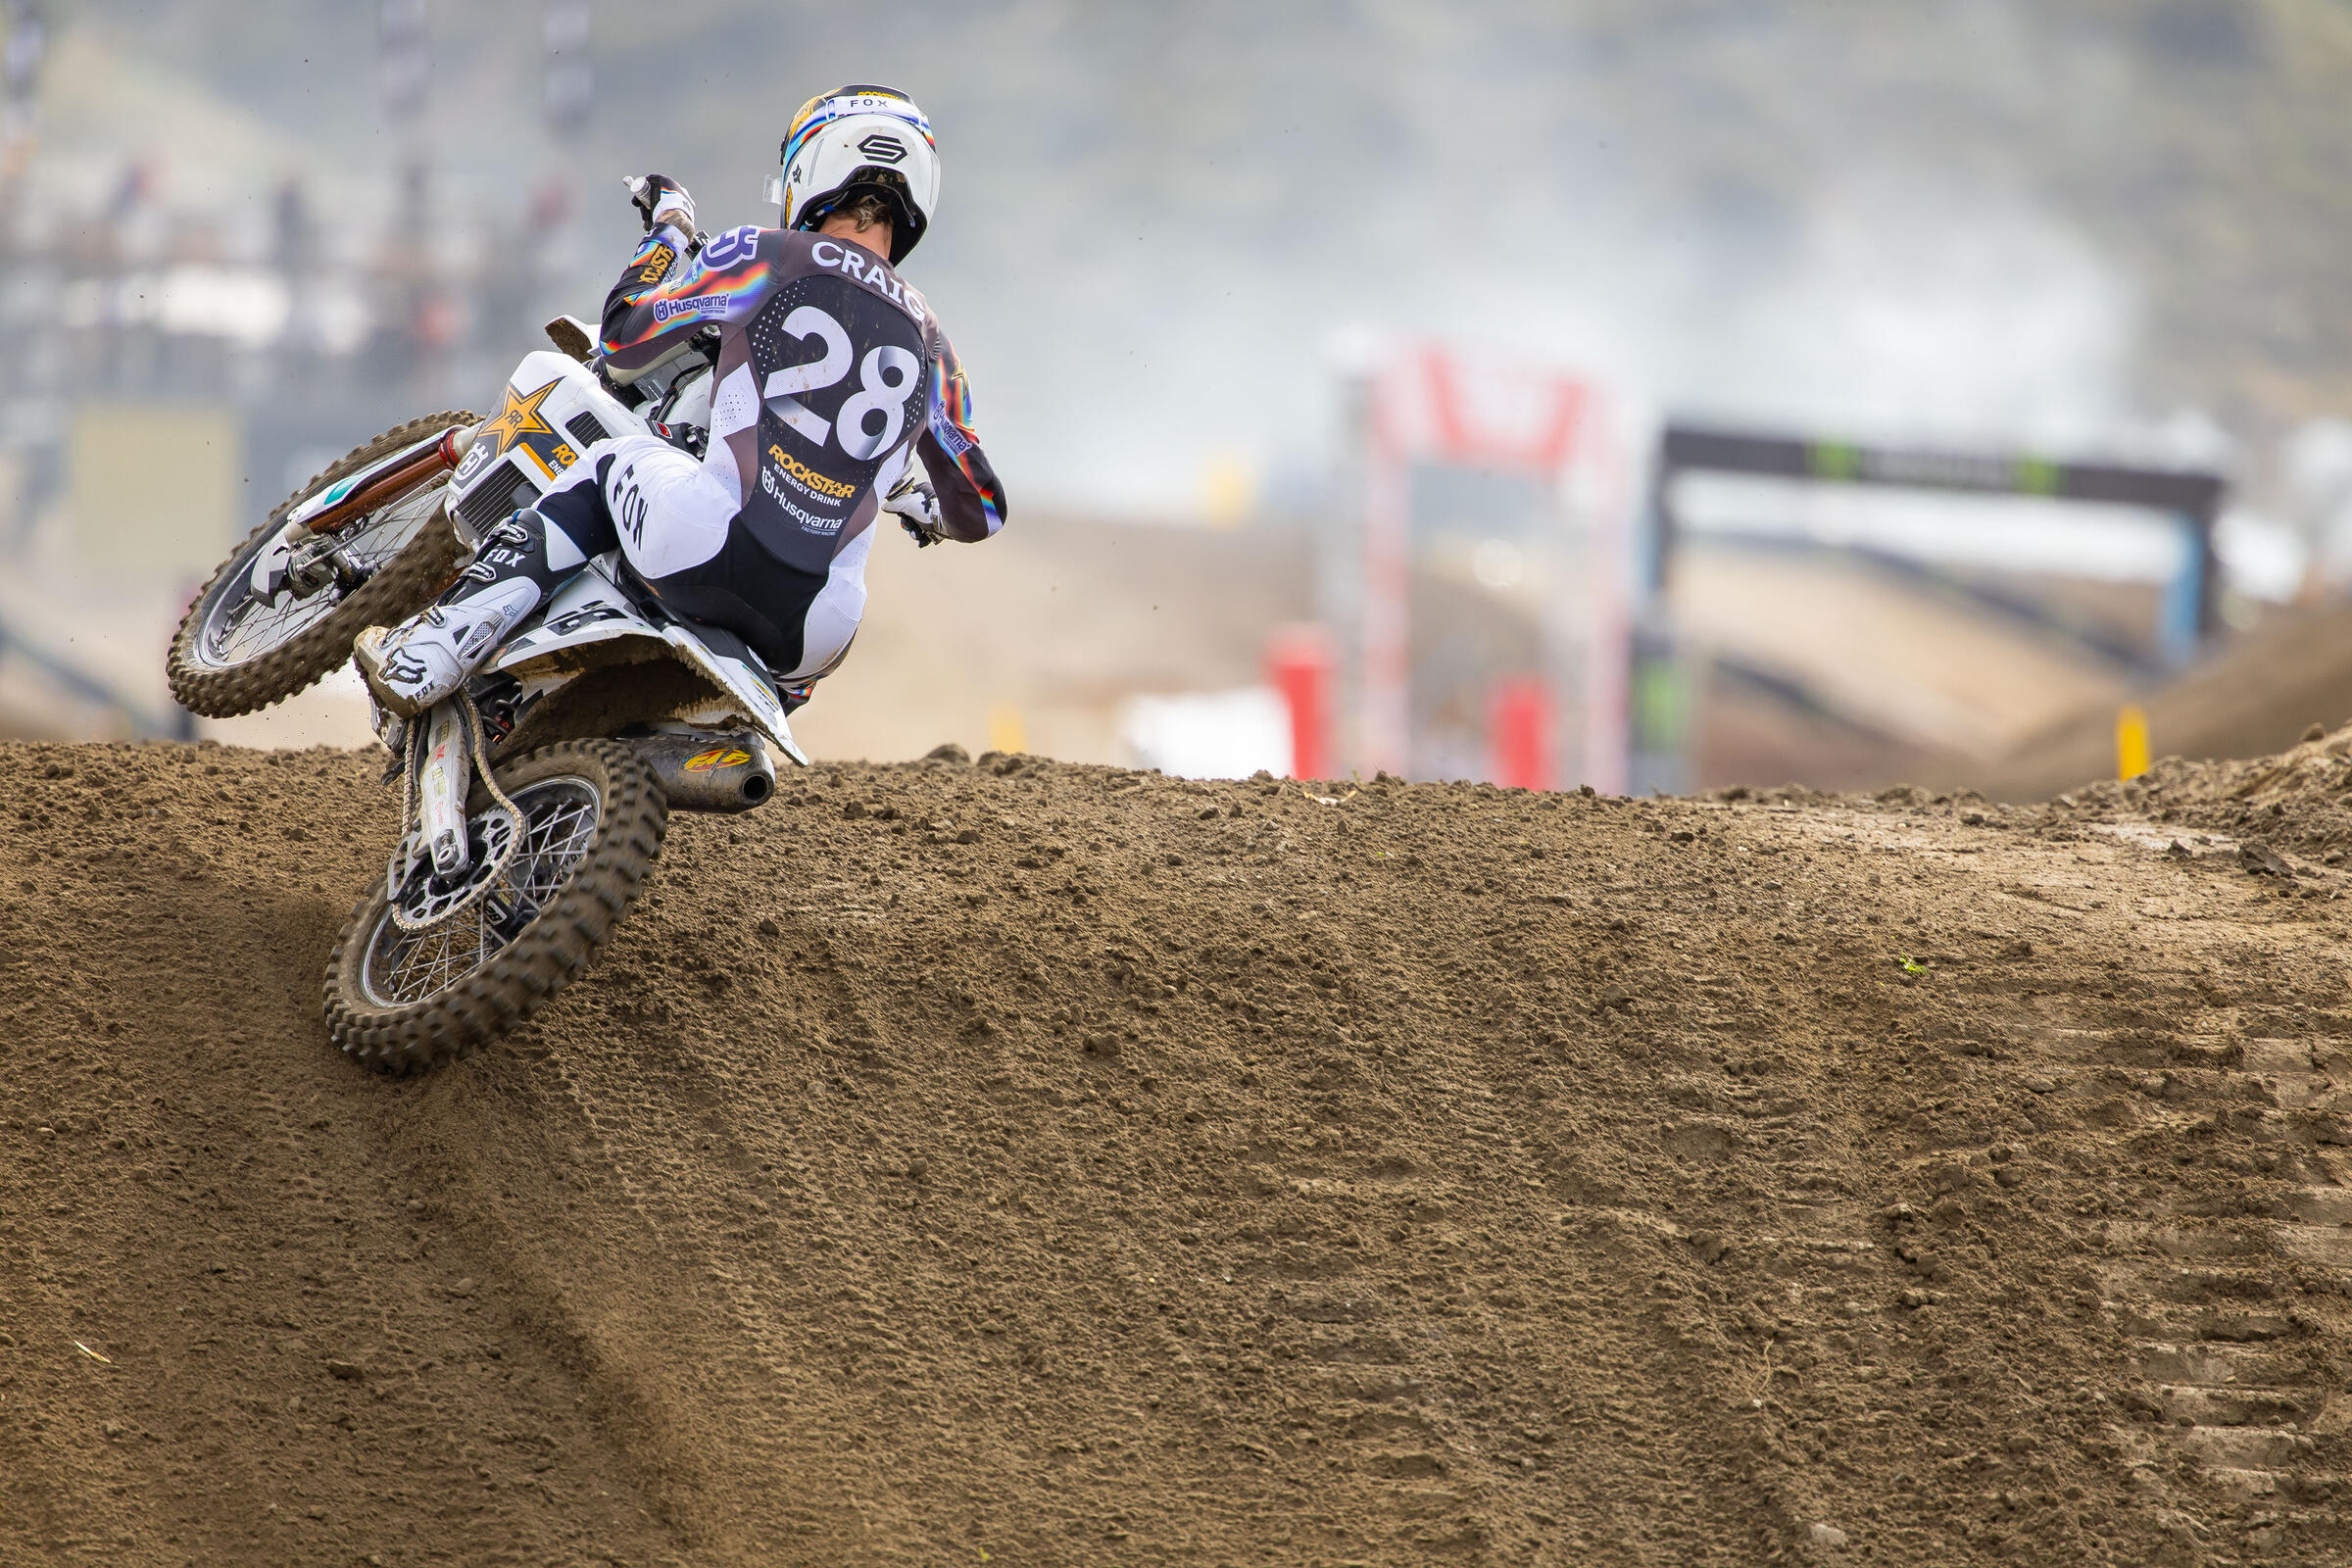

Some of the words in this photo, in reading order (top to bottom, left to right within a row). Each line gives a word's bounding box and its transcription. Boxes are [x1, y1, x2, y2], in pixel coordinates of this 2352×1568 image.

[850, 98, 888, 108] FOX
[811, 241, 925, 321] CRAIG
[669, 295, 727, 315] Husqvarna
[763, 306, 919, 461] 28
[552, 443, 577, 469] RO
[768, 444, 856, 498] ROCKSTAR
[613, 464, 648, 551] FOX
[774, 464, 809, 495] ENERGY
[809, 490, 842, 508] DRINK
[773, 487, 843, 530] Husqvarna
[483, 549, 526, 568] FOX
